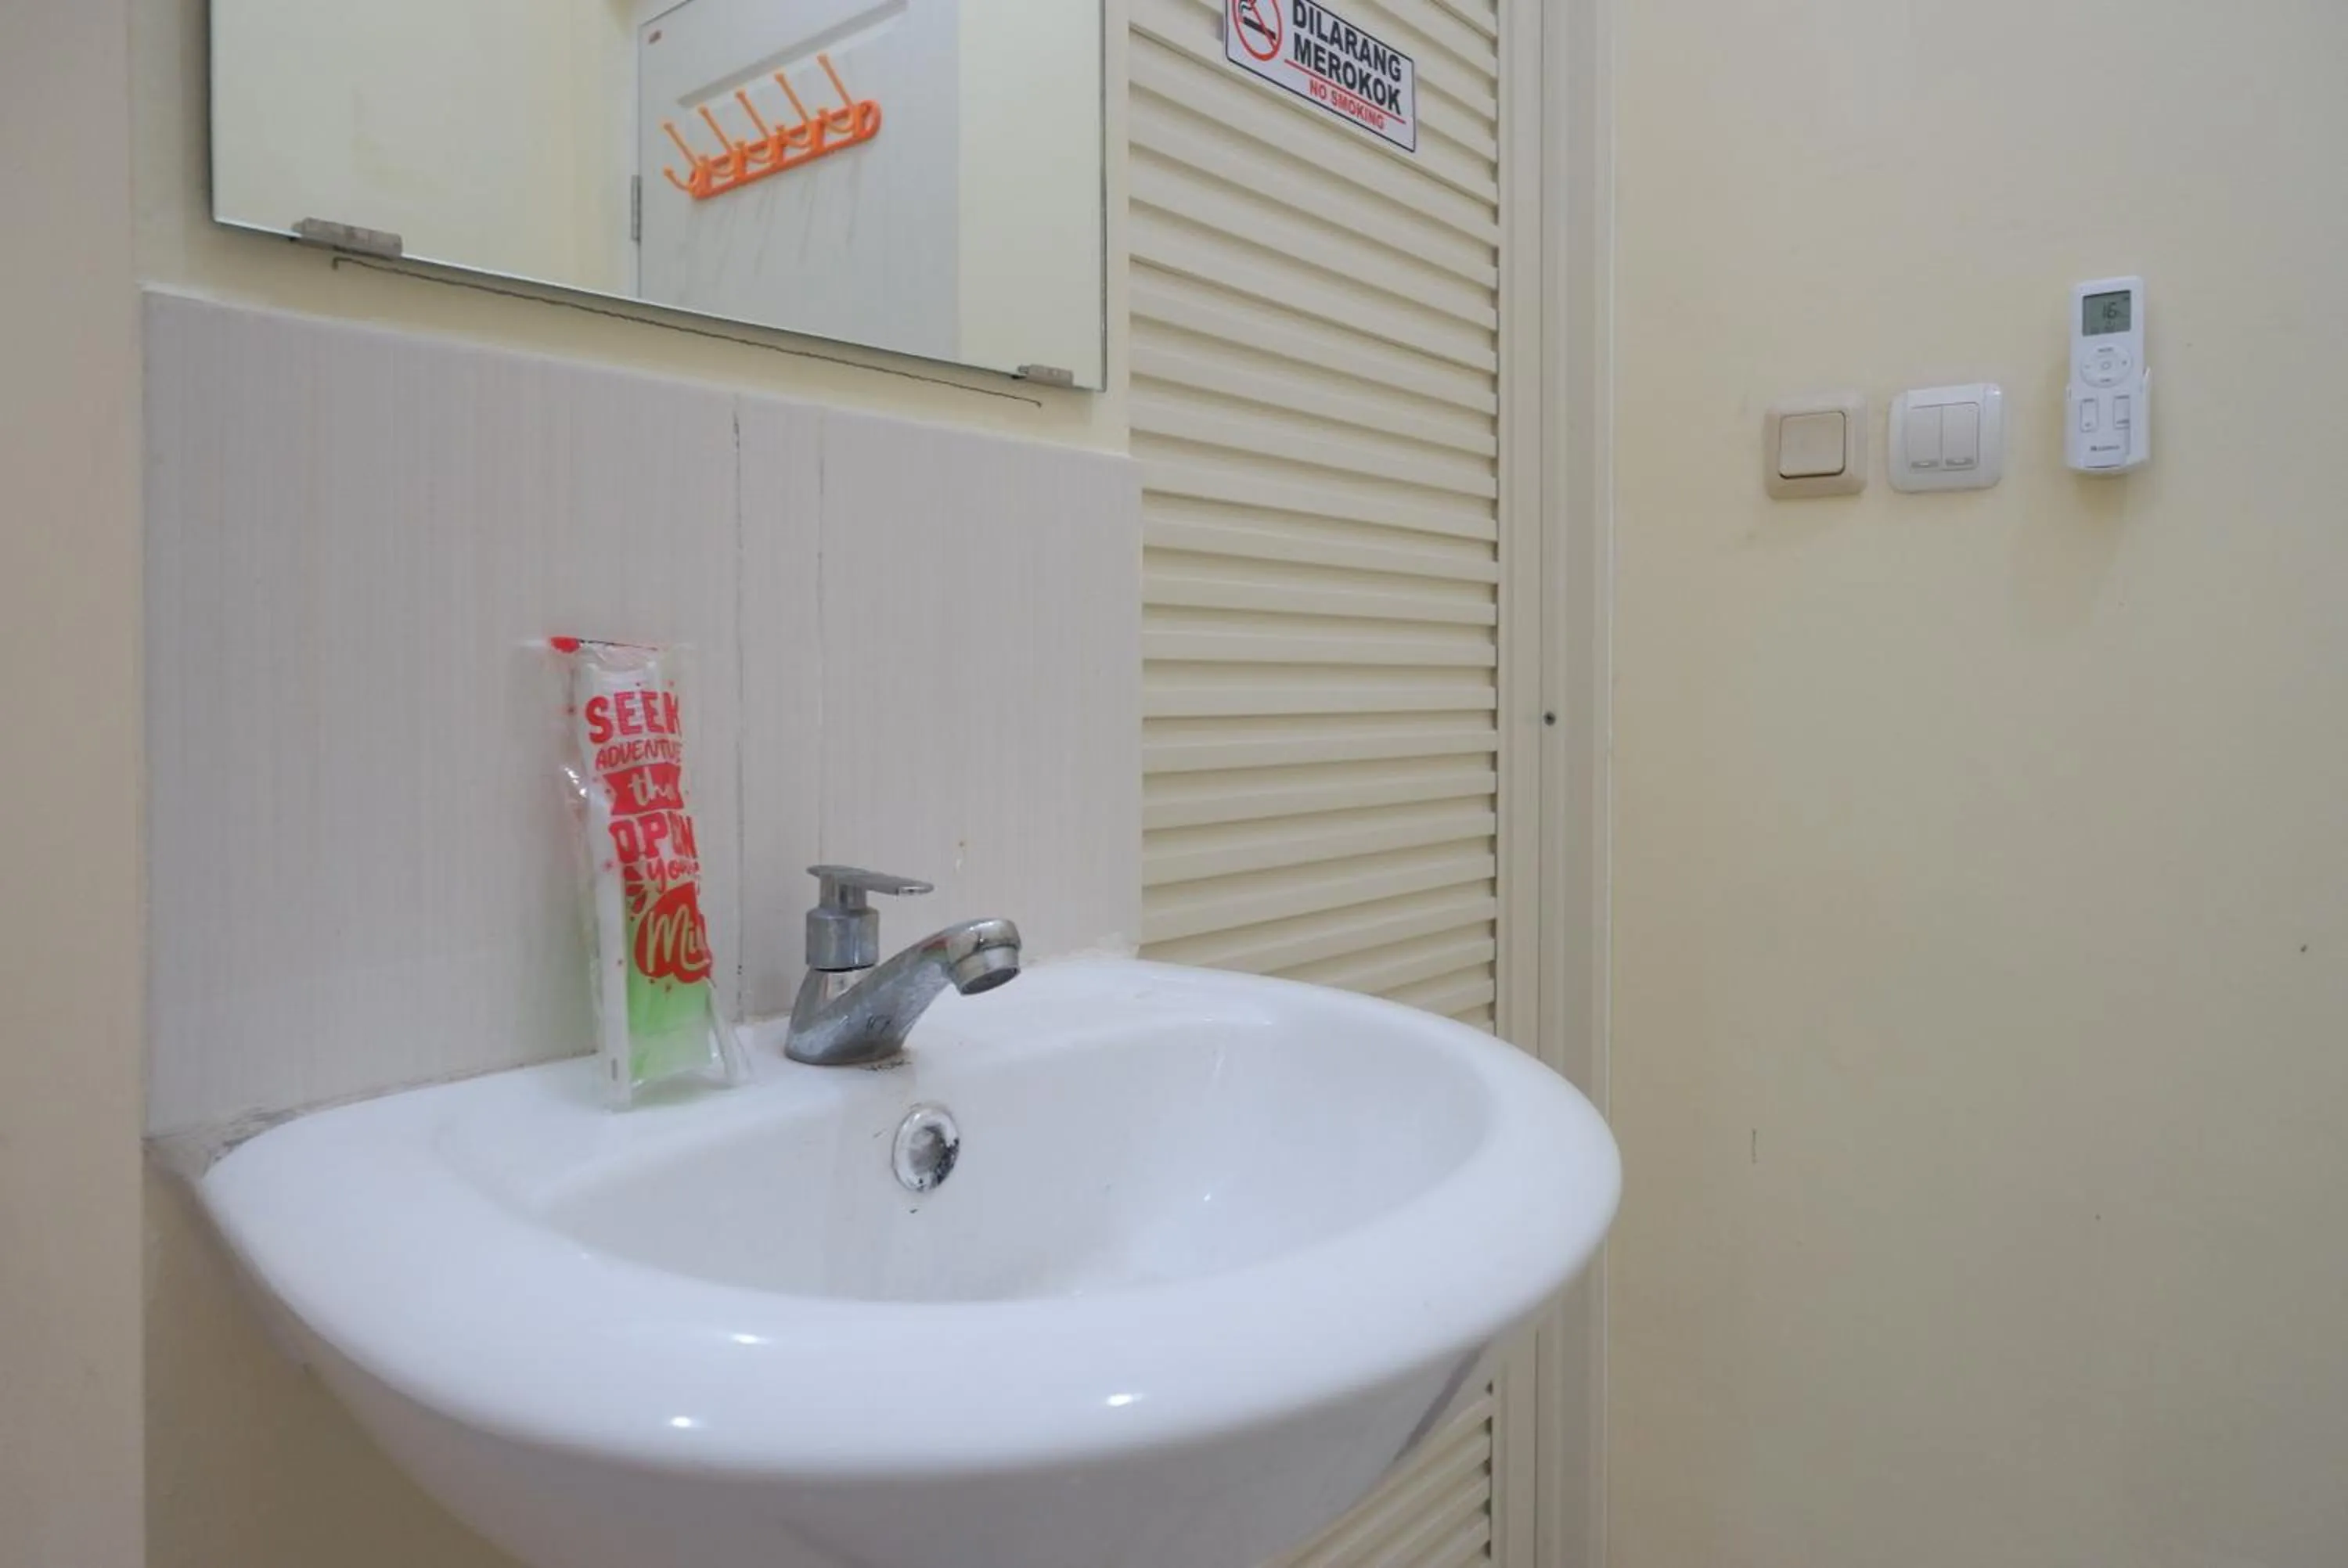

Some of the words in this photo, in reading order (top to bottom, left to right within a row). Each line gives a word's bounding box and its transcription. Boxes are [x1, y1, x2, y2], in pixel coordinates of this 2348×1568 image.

[1292, 0, 1401, 82] DILARANG
[1294, 31, 1401, 115] MEROKOK
[1309, 79, 1327, 100] NO
[1331, 90, 1385, 130] SMOKING
[585, 691, 682, 745] SEEK
